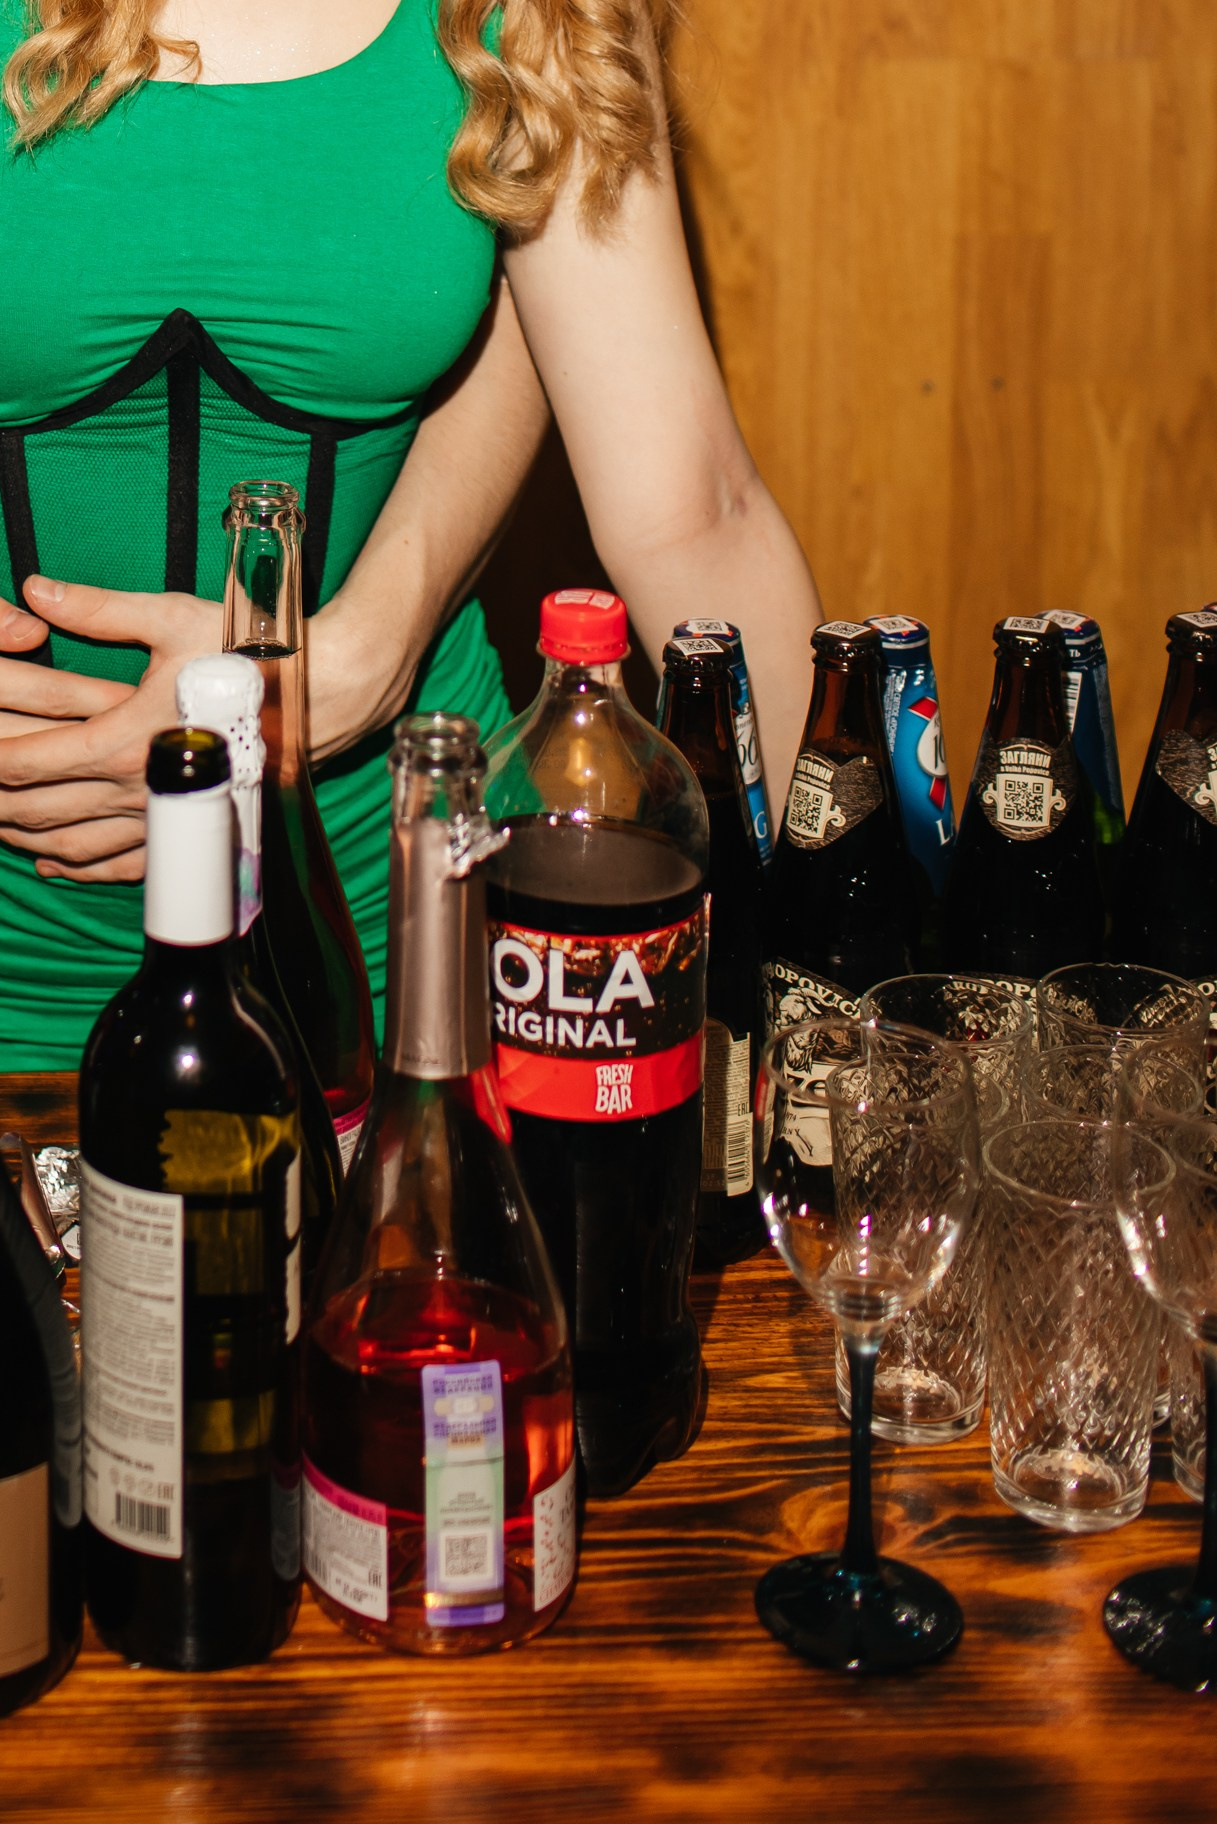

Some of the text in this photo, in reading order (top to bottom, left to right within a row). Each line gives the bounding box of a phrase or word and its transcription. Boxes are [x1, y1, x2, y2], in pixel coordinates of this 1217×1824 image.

[1000, 751, 1051, 768] ЗАГЛЯНИ
[492, 938, 655, 1013] OLA
[774, 963, 861, 1020] OPOVIC
[493, 1002, 637, 1048] RIGINAL
[595, 1063, 634, 1085] FRESH
[595, 1084, 633, 1115] BAR
[737, 1102, 749, 1117] EAC
